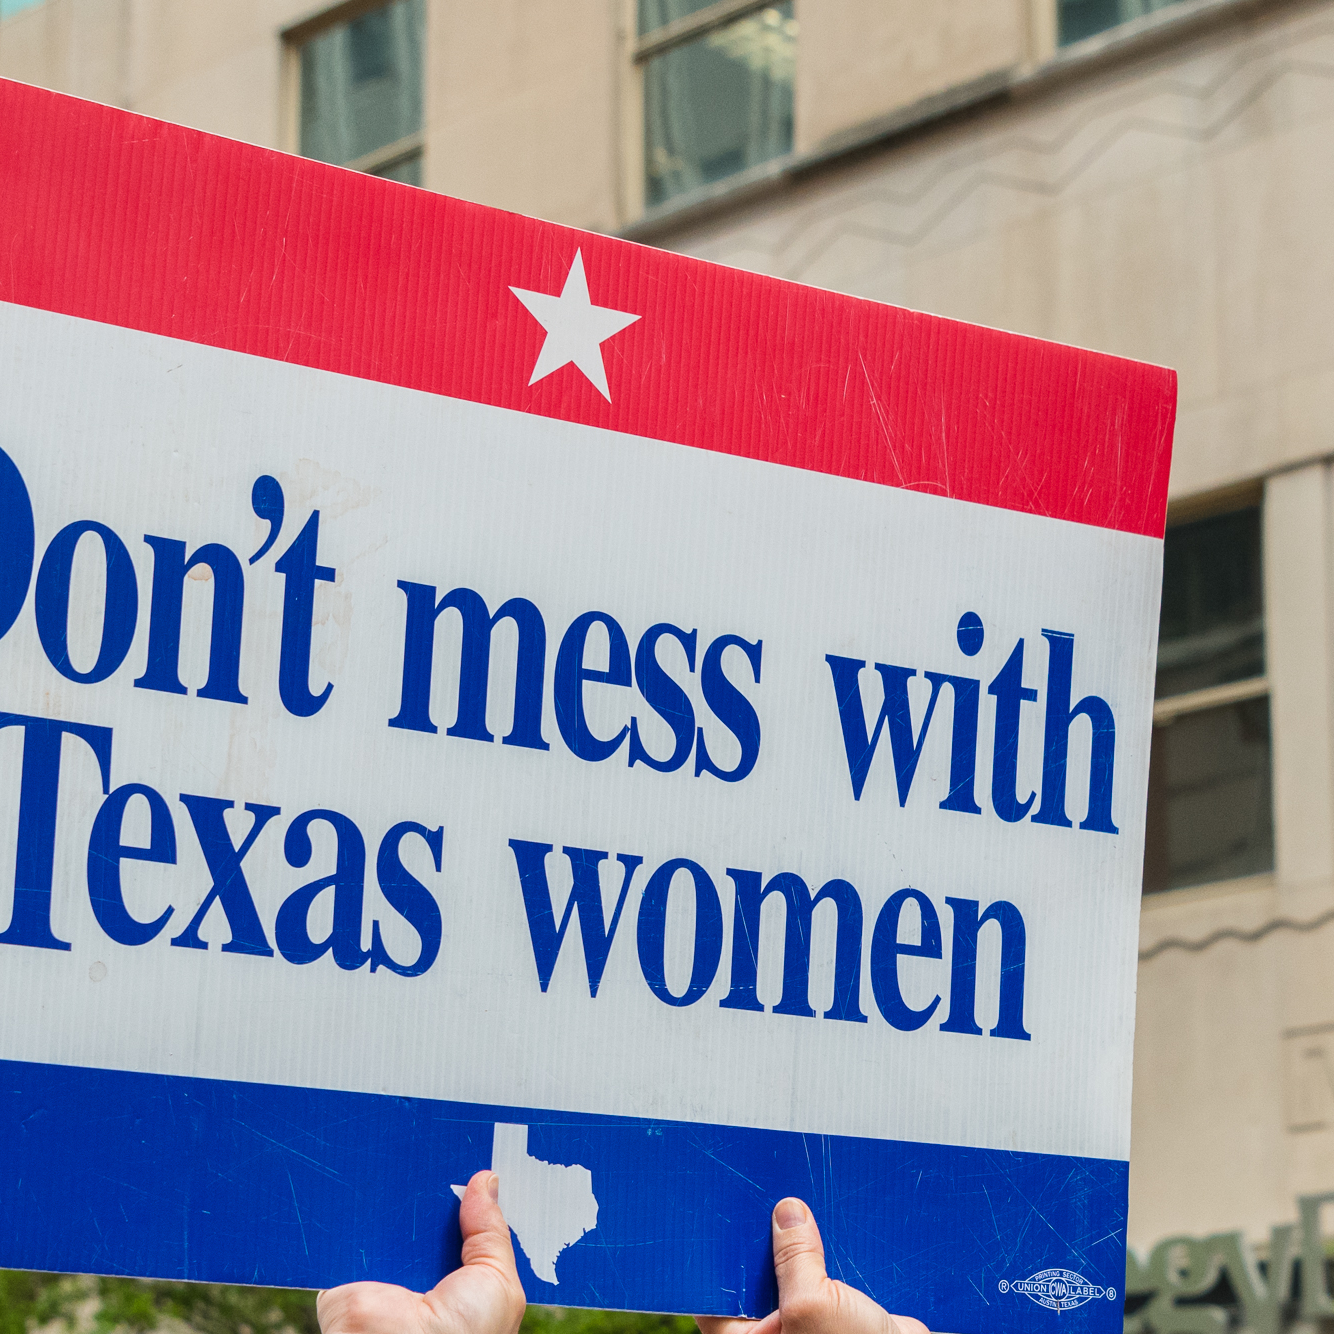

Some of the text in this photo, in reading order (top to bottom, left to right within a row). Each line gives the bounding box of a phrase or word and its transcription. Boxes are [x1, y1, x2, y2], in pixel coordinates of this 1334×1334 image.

[389, 580, 763, 783] mess
[825, 612, 1120, 836] with
[509, 839, 1032, 1042] women
[1035, 1271, 1084, 1284] PRINTING SECTOR
[1017, 1282, 1047, 1292] UNION
[1050, 1280, 1067, 1297] CWA
[1070, 1286, 1100, 1296] LABEL
[1039, 1297, 1079, 1308] AUSTIN TEXAS
